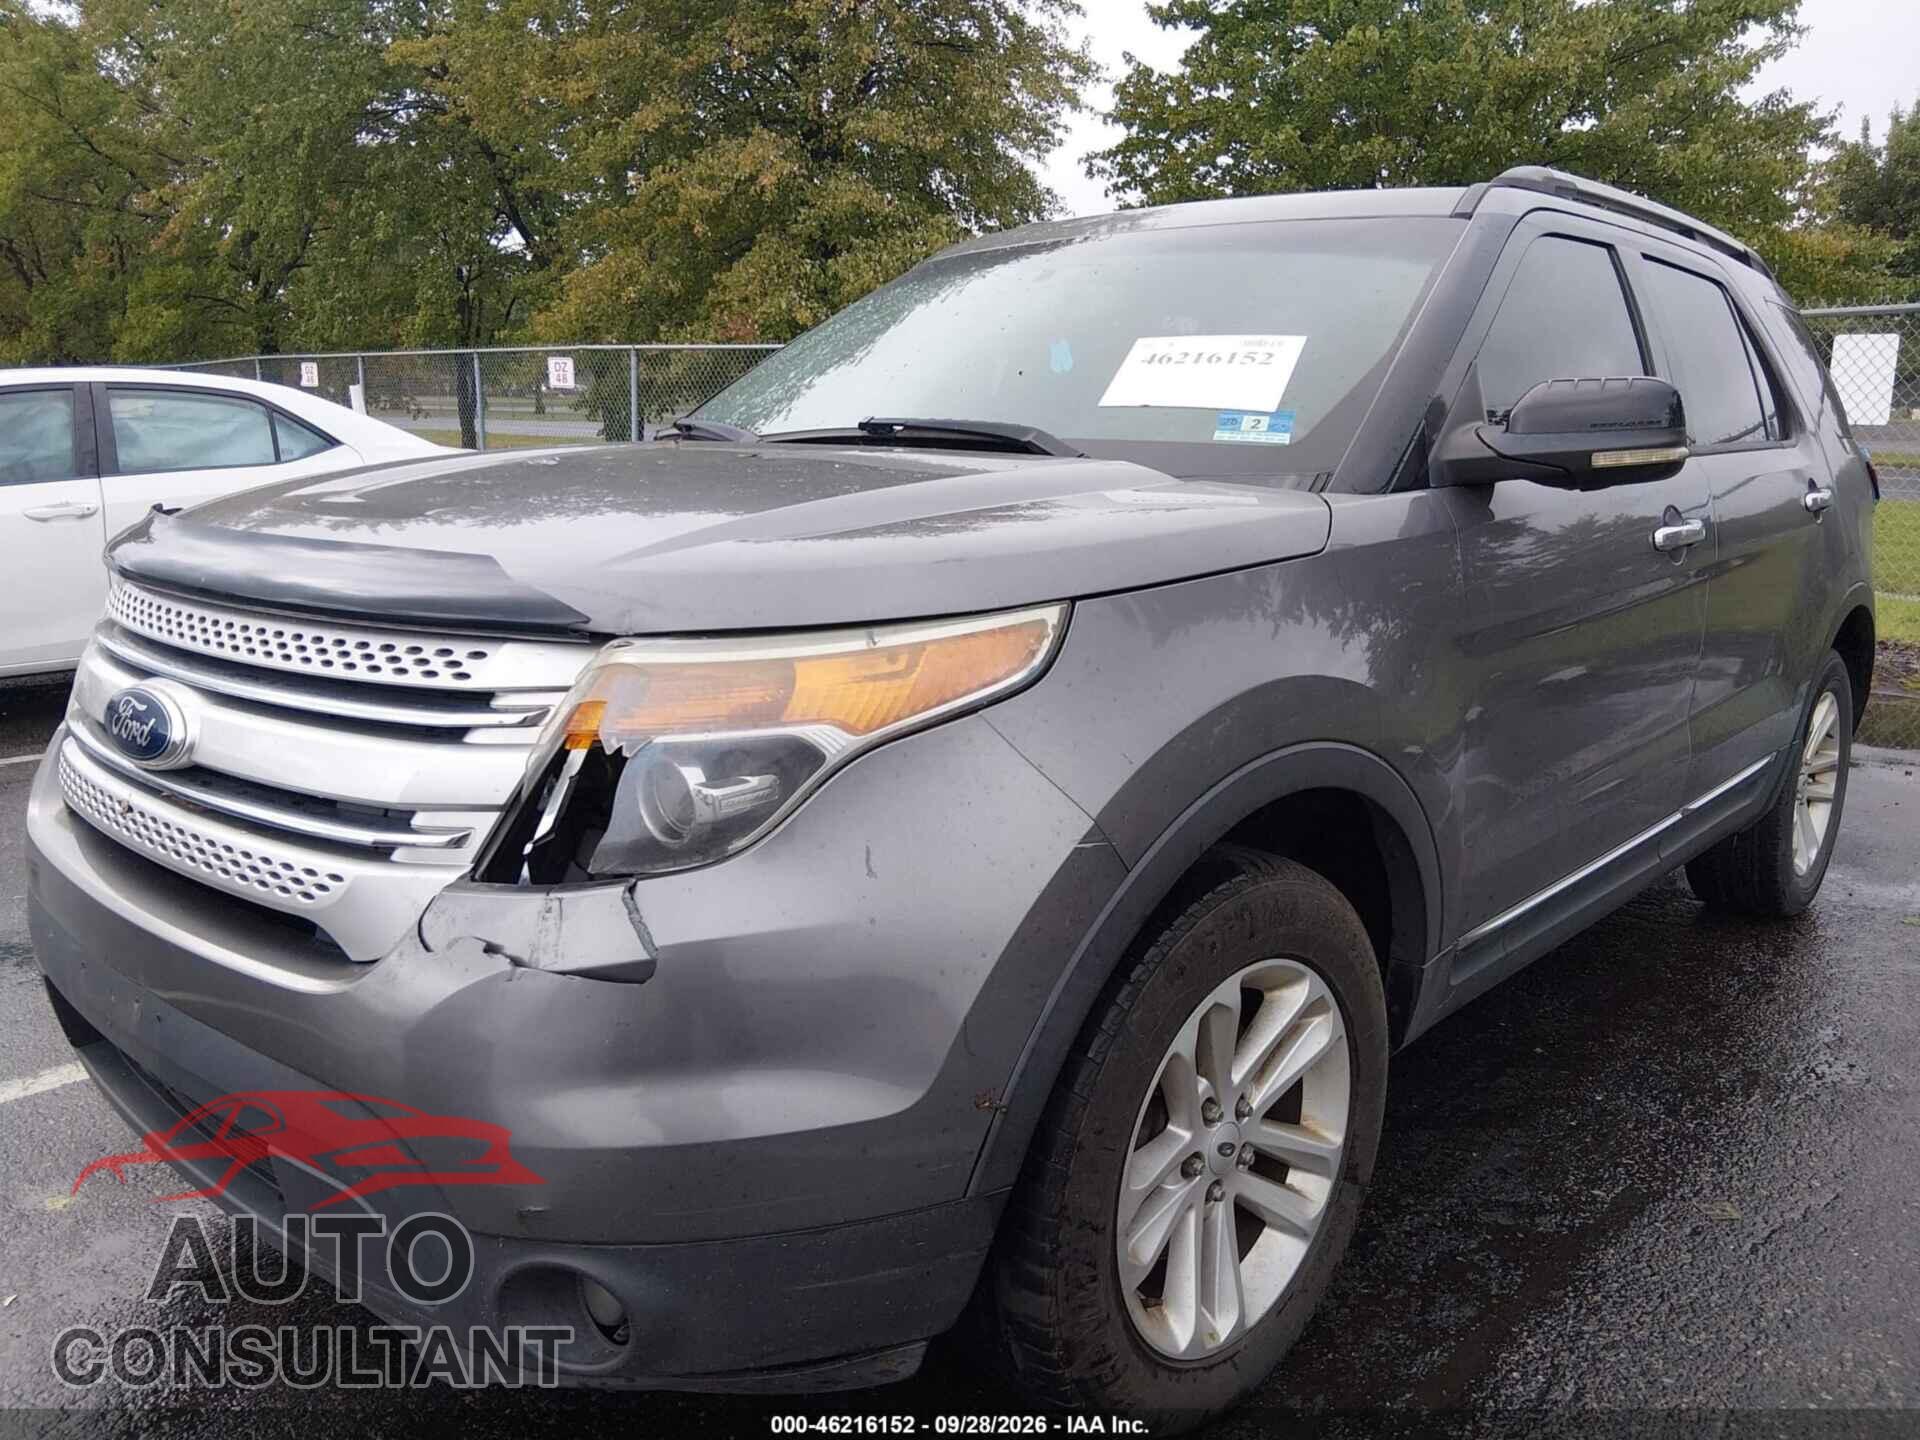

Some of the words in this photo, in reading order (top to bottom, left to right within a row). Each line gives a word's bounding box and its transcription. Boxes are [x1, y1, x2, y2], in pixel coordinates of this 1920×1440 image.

[1141, 351, 1276, 366] 46216152
[554, 361, 569, 373] DZ
[1250, 418, 1262, 430] 2
[112, 696, 155, 746] Ford
